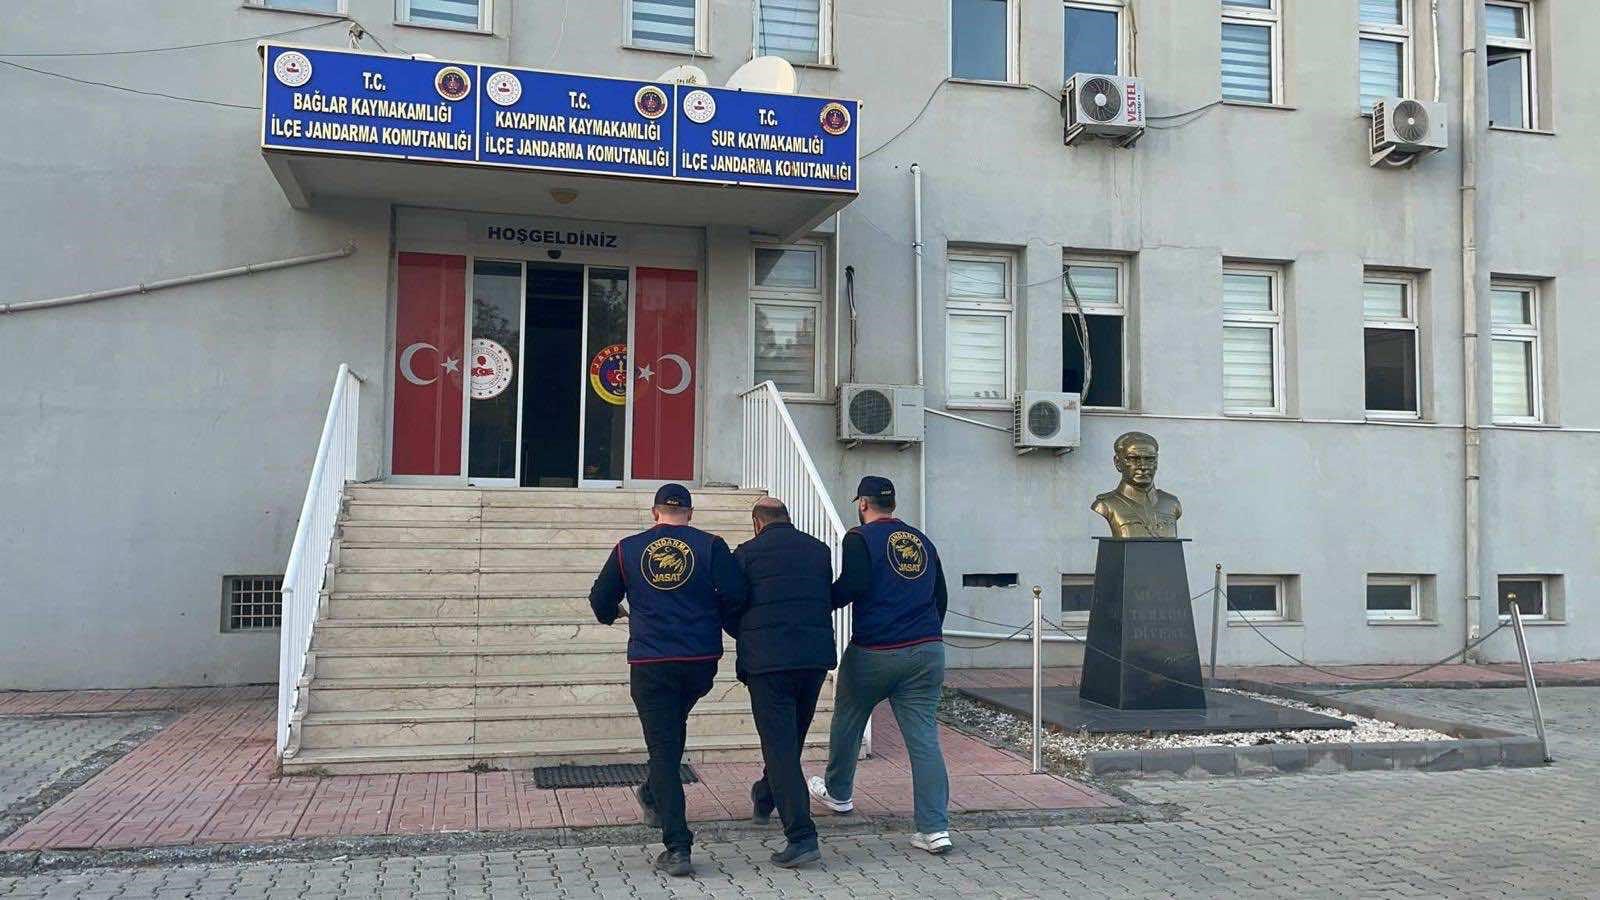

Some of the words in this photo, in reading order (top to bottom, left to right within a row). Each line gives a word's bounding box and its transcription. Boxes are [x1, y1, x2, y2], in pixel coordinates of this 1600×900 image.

[362, 71, 386, 91] T.C.
[293, 89, 348, 114] BAĞLAR
[351, 97, 452, 123] KAYMAKAMLIĞI
[568, 91, 590, 109] T.C.
[1126, 82, 1137, 122] VESTEL
[495, 110, 565, 133] KAYAPINAR
[568, 117, 661, 141] KAYMAKAMLIĞI
[758, 109, 778, 127] T.C.
[271, 113, 302, 138] İLÇE
[305, 120, 379, 144] JANDARMA
[382, 126, 471, 151] KOMUTANLIĞI
[711, 129, 735, 148] SUR
[738, 132, 824, 155] KAYMAKAMLIĞI
[485, 131, 514, 155] İLÇE
[517, 138, 584, 160] JANDARMA
[587, 144, 669, 168] KOMUTANLIĞI
[682, 148, 708, 171] İLÇE
[710, 154, 773, 175] JANDARMA
[775, 159, 852, 181] KOMUTANLIĞI
[488, 226, 617, 248] HOŞGELDİNİZ
[647, 539, 690, 556] JANDARMA
[652, 573, 682, 583] JASAT
[898, 563, 921, 572] JASAT
